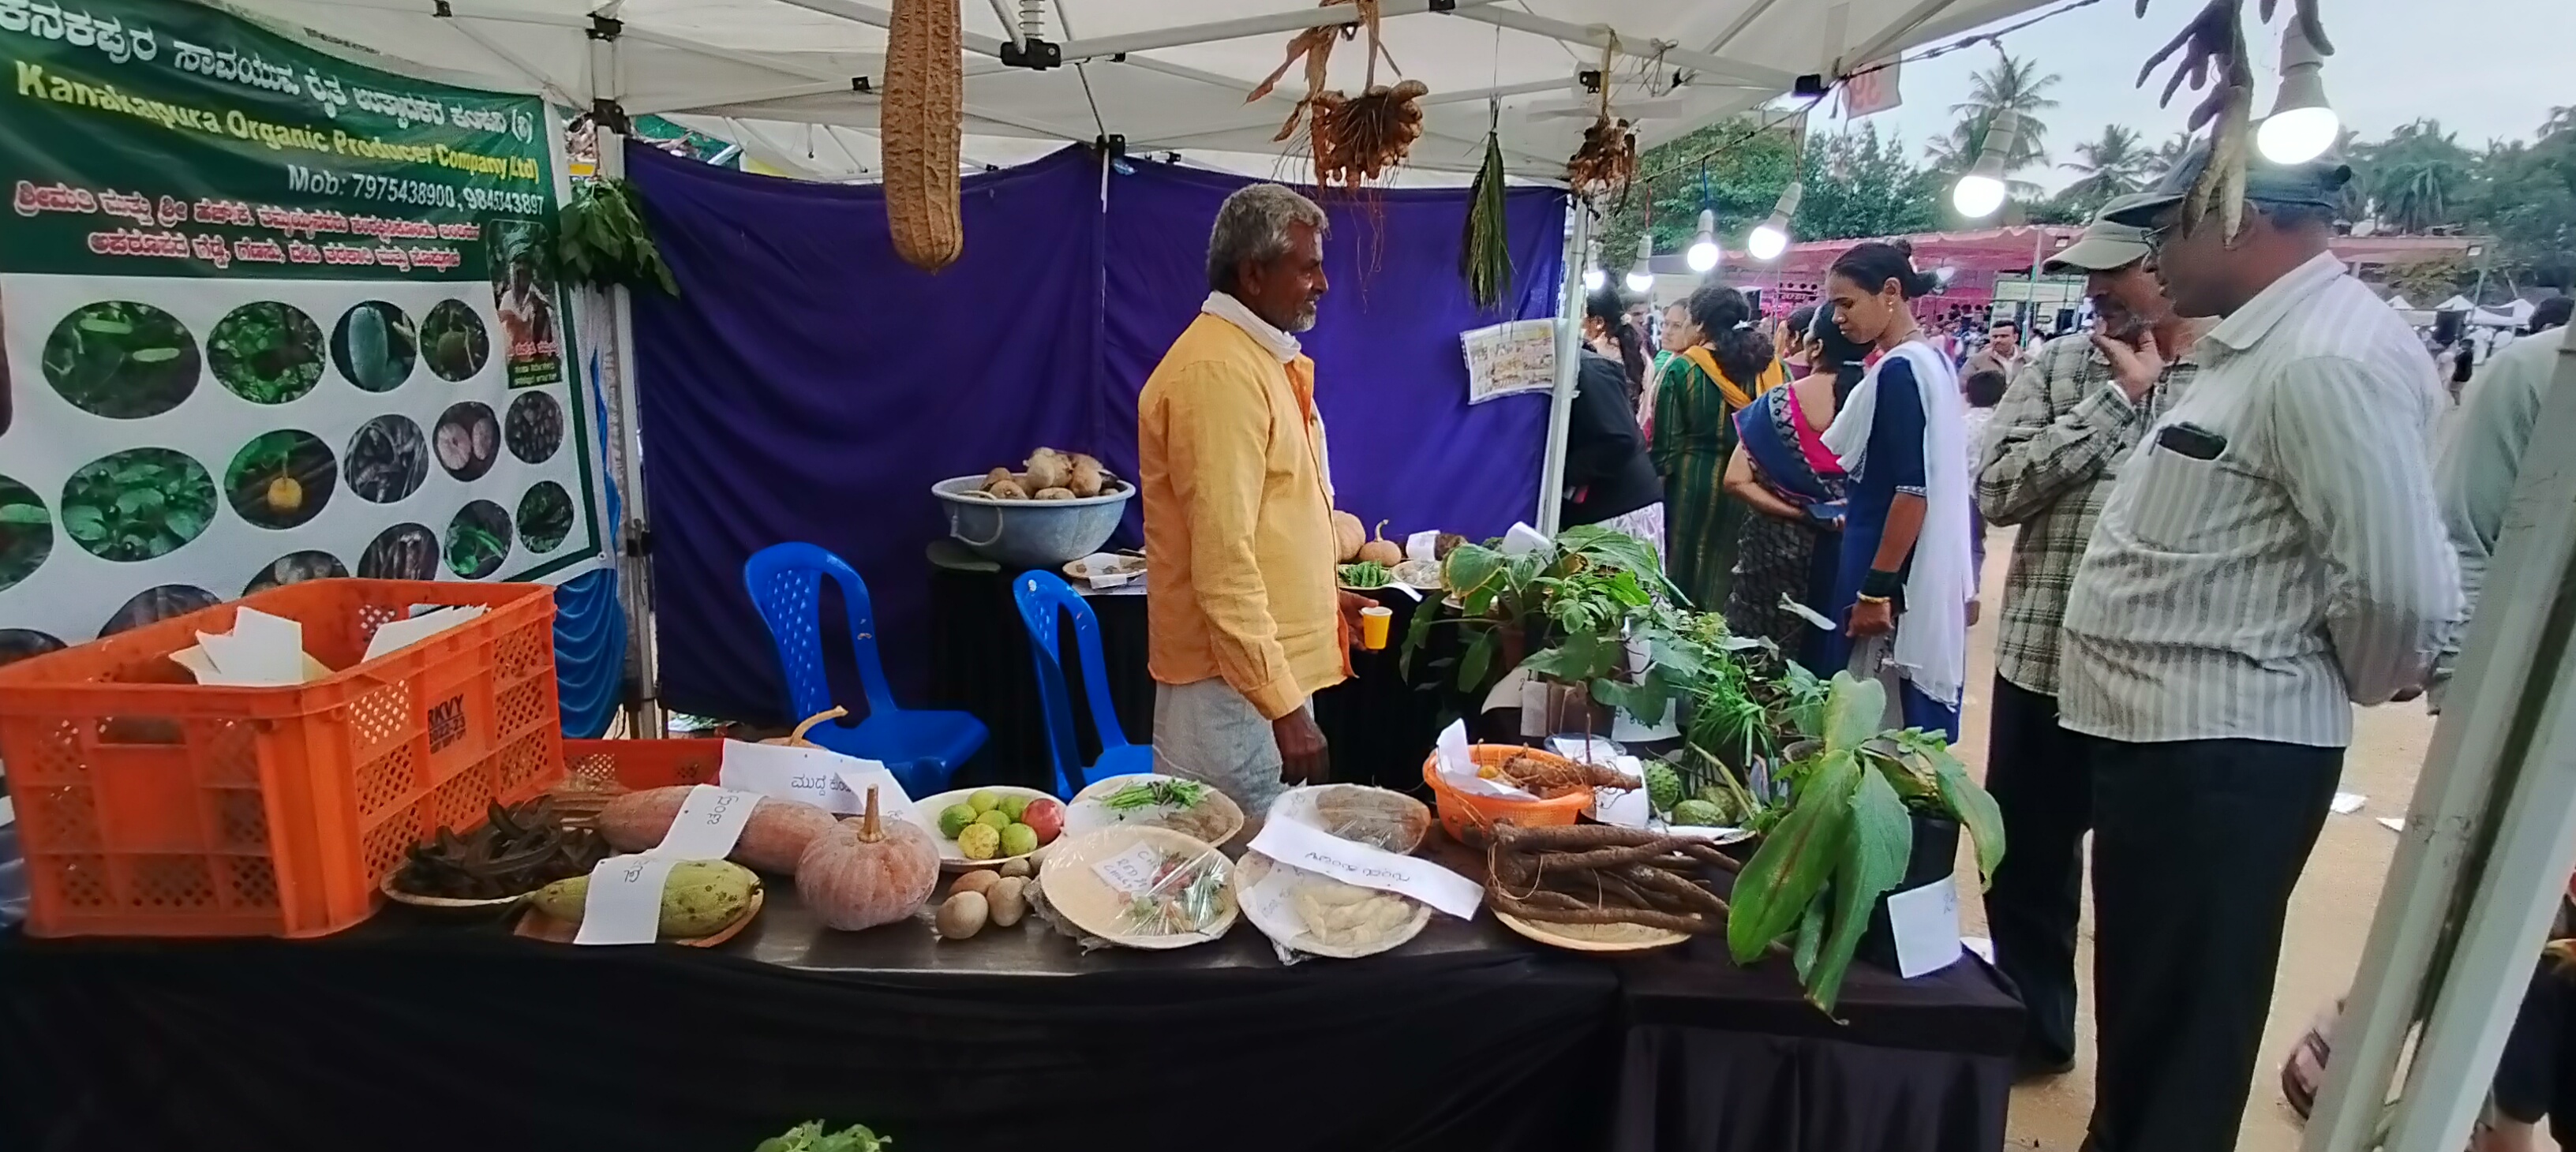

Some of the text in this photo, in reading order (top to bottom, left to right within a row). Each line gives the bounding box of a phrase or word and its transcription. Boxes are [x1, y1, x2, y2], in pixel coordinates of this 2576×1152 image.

[0, 0, 157, 64] ಕನಕಪುರ
[305, 68, 348, 118] ರೈತ
[16, 60, 223, 133] Kanakapura
[227, 110, 330, 152] Organic
[333, 130, 432, 164] Producer
[287, 163, 347, 196] Mob:
[14, 180, 99, 217] ಶ್ರೀಮತಿ
[99, 188, 155, 226] ಮತ್ತು
[158, 195, 188, 228] ಶ್ರೀ
[428, 693, 464, 732] RKVY
[792, 772, 826, 796] ಮುದ್ದೆ
